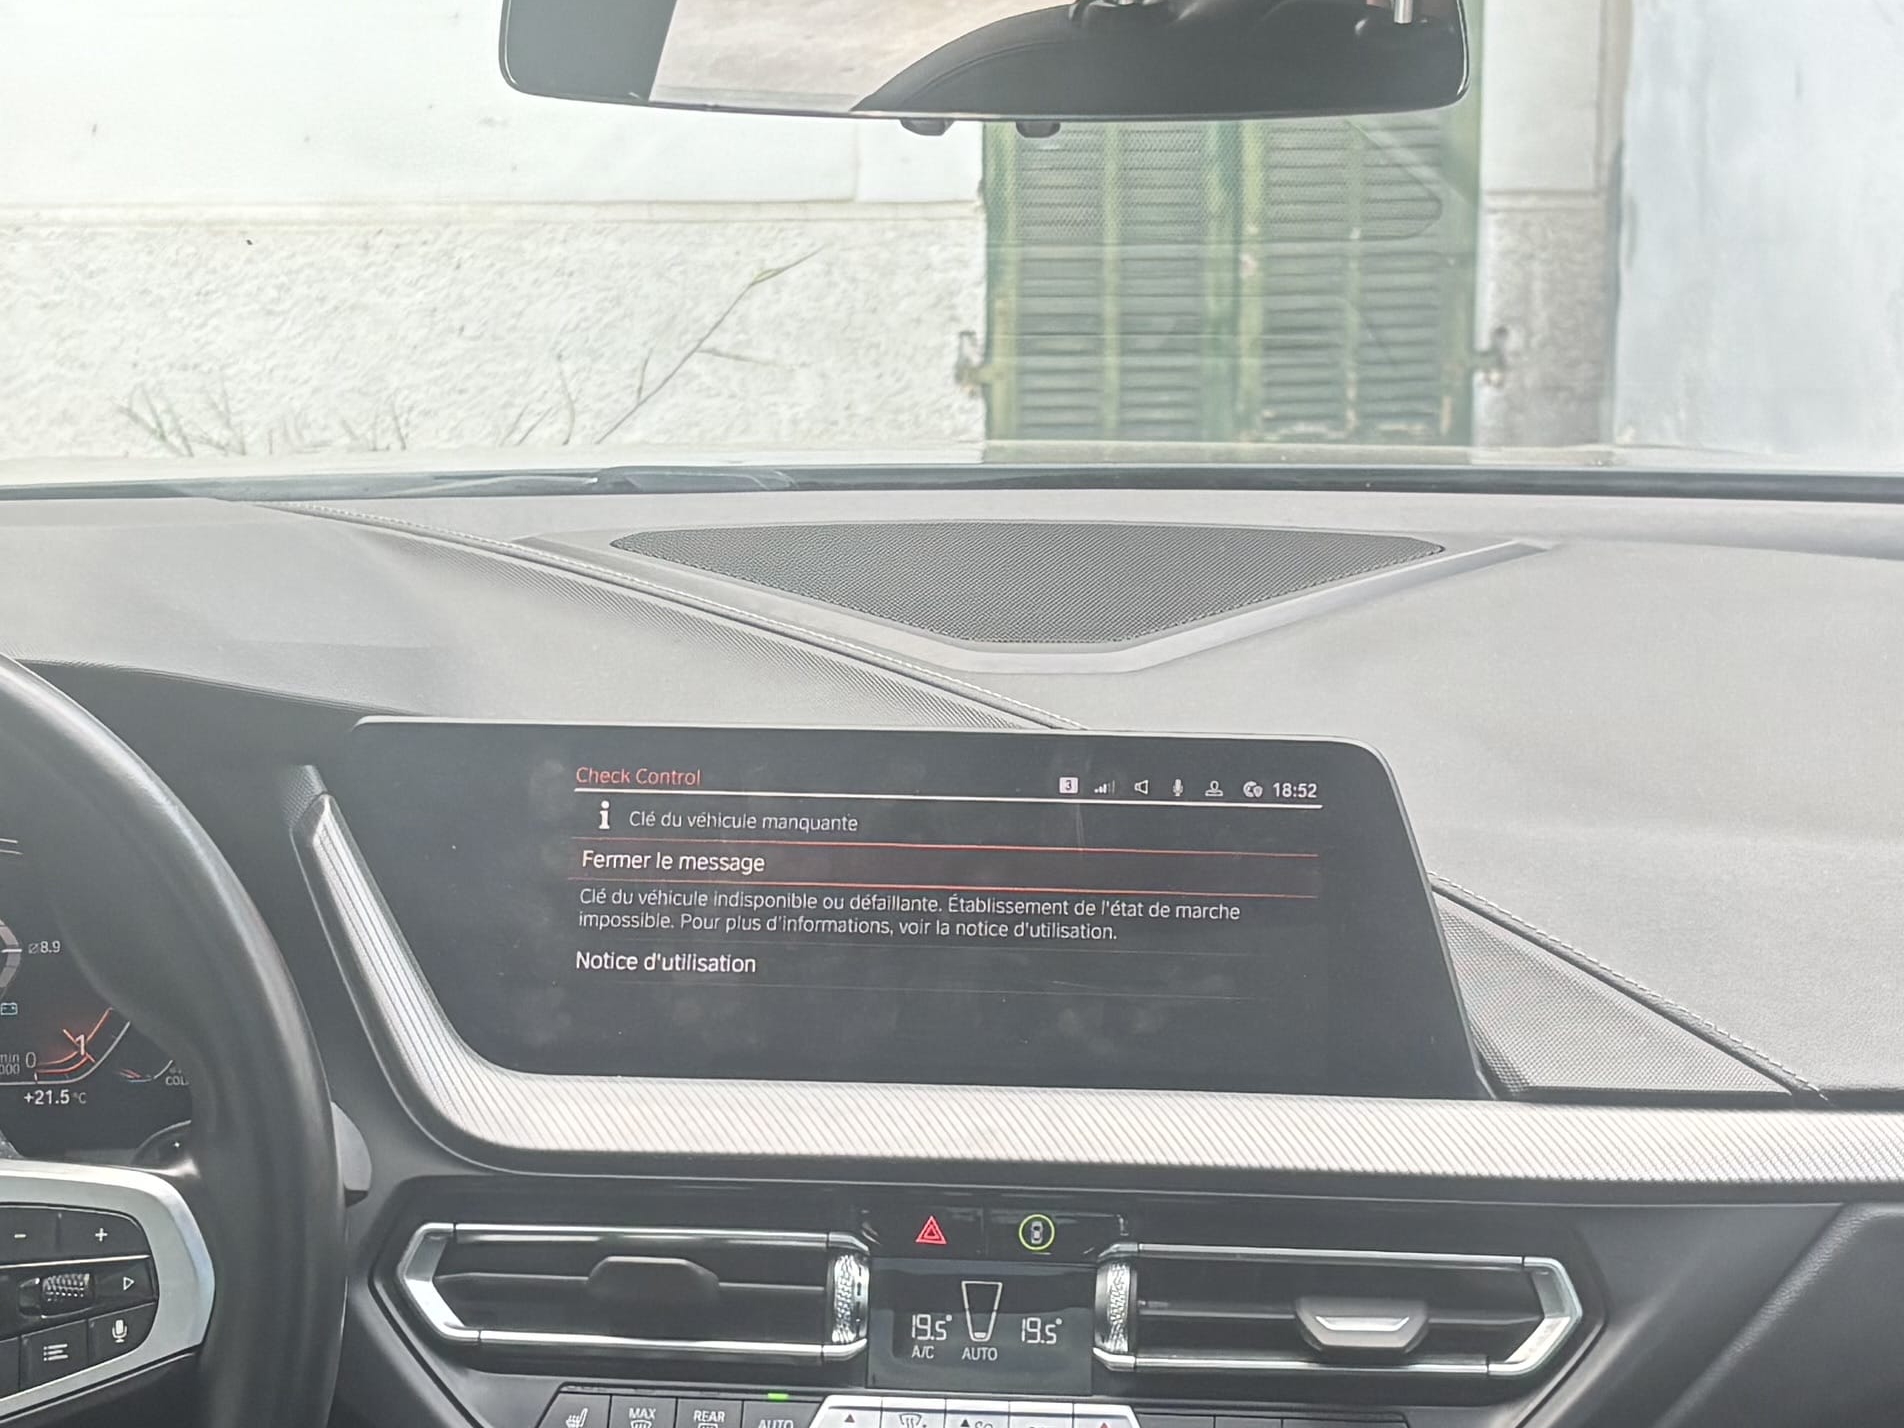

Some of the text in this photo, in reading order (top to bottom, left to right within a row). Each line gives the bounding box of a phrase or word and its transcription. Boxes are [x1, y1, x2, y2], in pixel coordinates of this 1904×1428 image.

[576, 767, 701, 786] Check Control
[1273, 782, 1318, 798] 18:52
[629, 810, 858, 833] Clé du véhicule manquante
[582, 850, 765, 875] Fermer le message
[580, 888, 1240, 920] Clé du véhicule indisponible ou défaillante. Établissement de l'état de marche
[579, 912, 1118, 940] impossible. Pour plus d'informations, voir la notice d'utilisation.
[576, 951, 756, 973] Notice d'utilisation
[912, 1345, 934, 1359] A/C
[962, 1347, 998, 1361] AUTO
[628, 1407, 656, 1422] MAX
[693, 1409, 725, 1424] REAR
